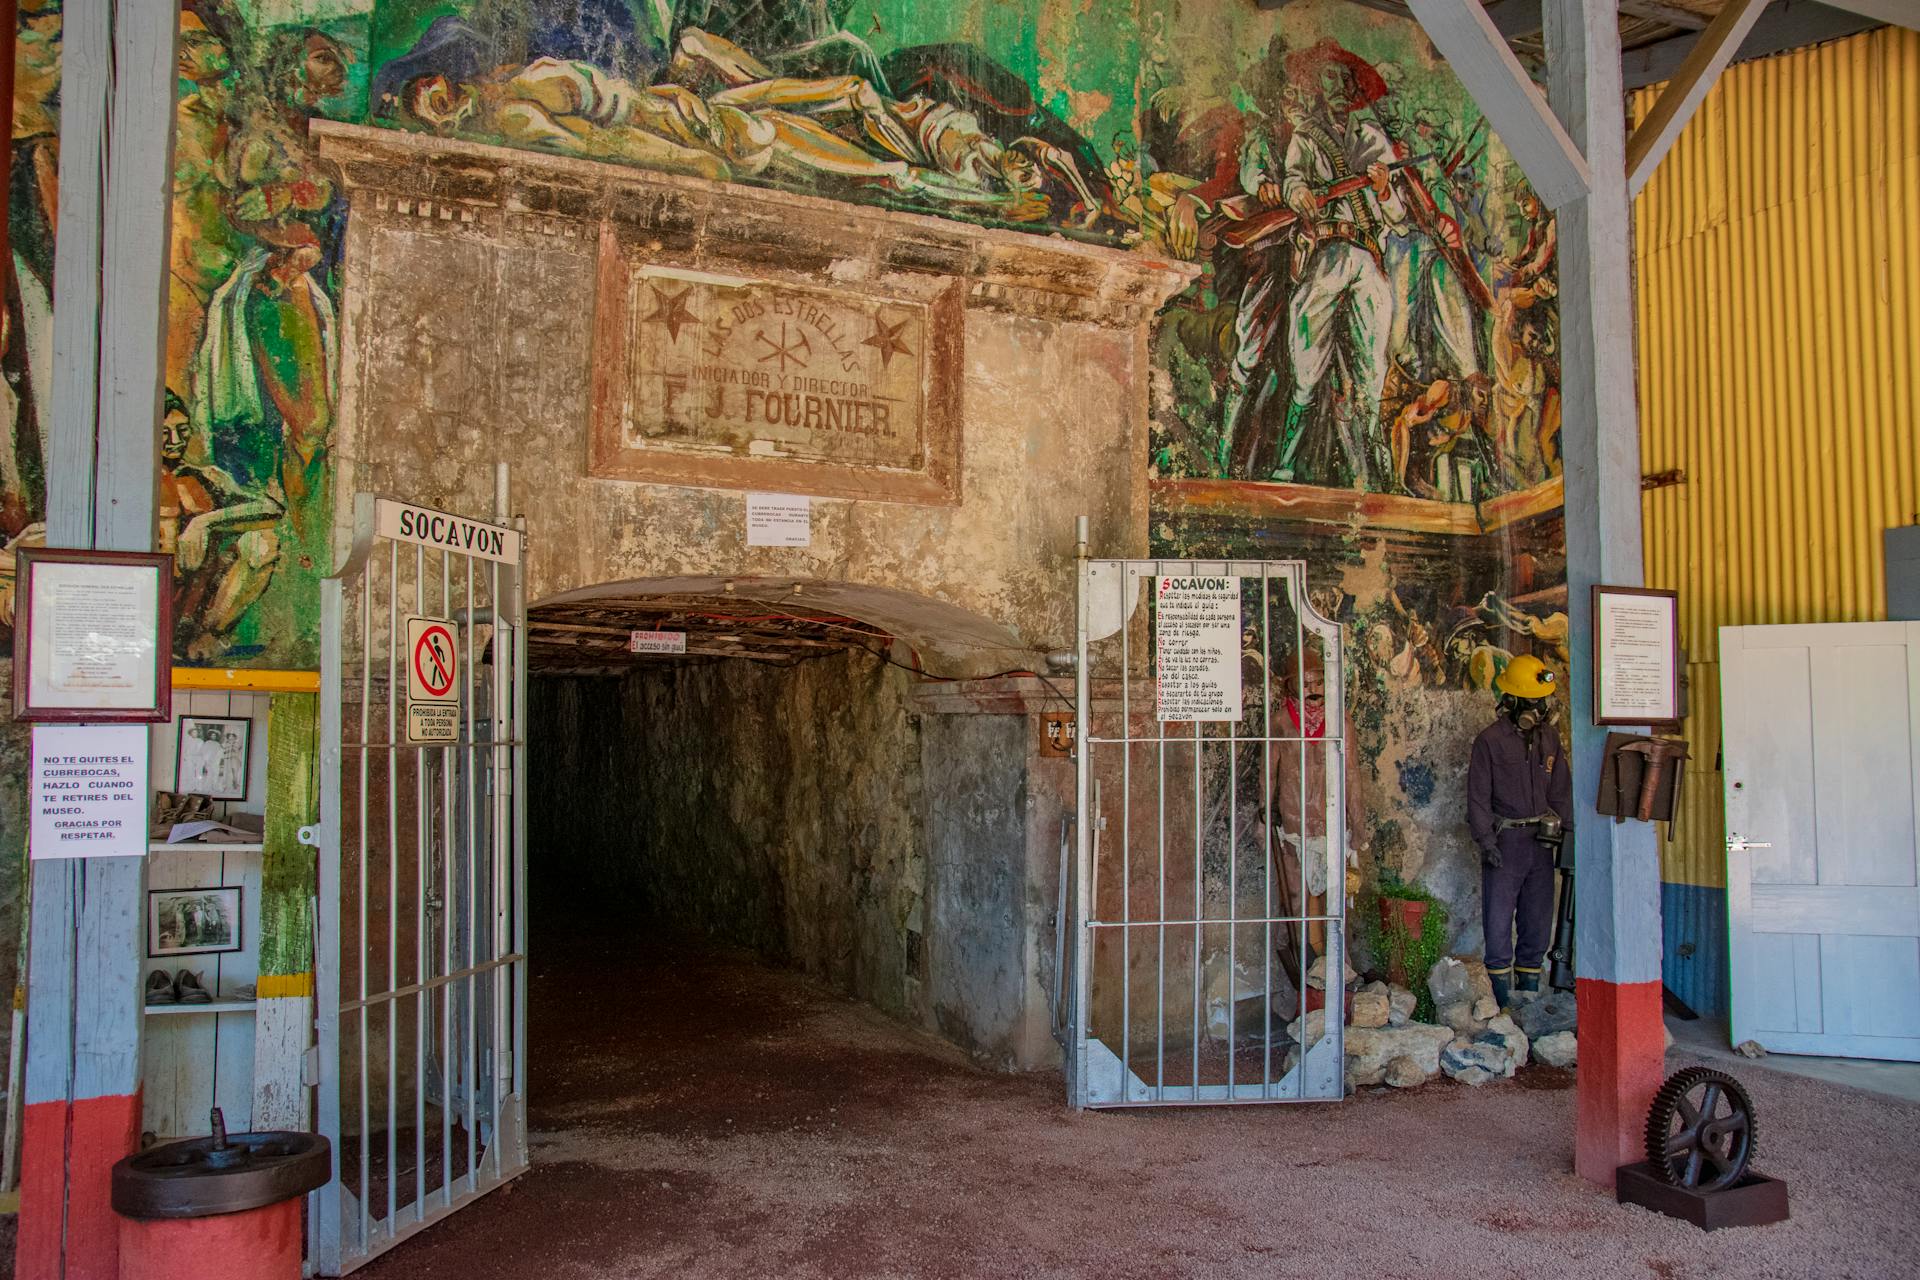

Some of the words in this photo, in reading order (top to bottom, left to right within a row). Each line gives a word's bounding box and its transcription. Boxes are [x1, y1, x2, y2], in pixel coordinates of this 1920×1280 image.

[702, 316, 732, 359] LAS
[732, 299, 766, 325] DOS
[773, 296, 861, 373] ESTRELLAS
[693, 365, 770, 389] INICIADOR
[777, 374, 788, 390] Y
[793, 376, 868, 398] DIRECTOR
[400, 509, 505, 556] SOCAVON
[635, 632, 680, 641] PROHIBIDO
[1182, 630, 1200, 638] riesgo.
[640, 642, 660, 650] acceso
[661, 641, 670, 651] sin
[1171, 672, 1179, 680] del
[1190, 681, 1199, 689] los
[1208, 691, 1223, 699] grupo
[413, 708, 435, 717] PROHIBIDA
[437, 708, 442, 717] LA
[442, 708, 456, 717] ENTRADA
[425, 718, 435, 726] TODA
[436, 718, 452, 727] PERSONA
[429, 728, 451, 736] AUTORIZADA
[43, 756, 59, 764] NO
[43, 769, 120, 777] CUBREBOCAS,
[62, 794, 108, 802] RETIRES
[43, 807, 85, 815] MUSEO.
[54, 820, 99, 828] GRACIAS
[60, 832, 116, 840] RESPETAR.
